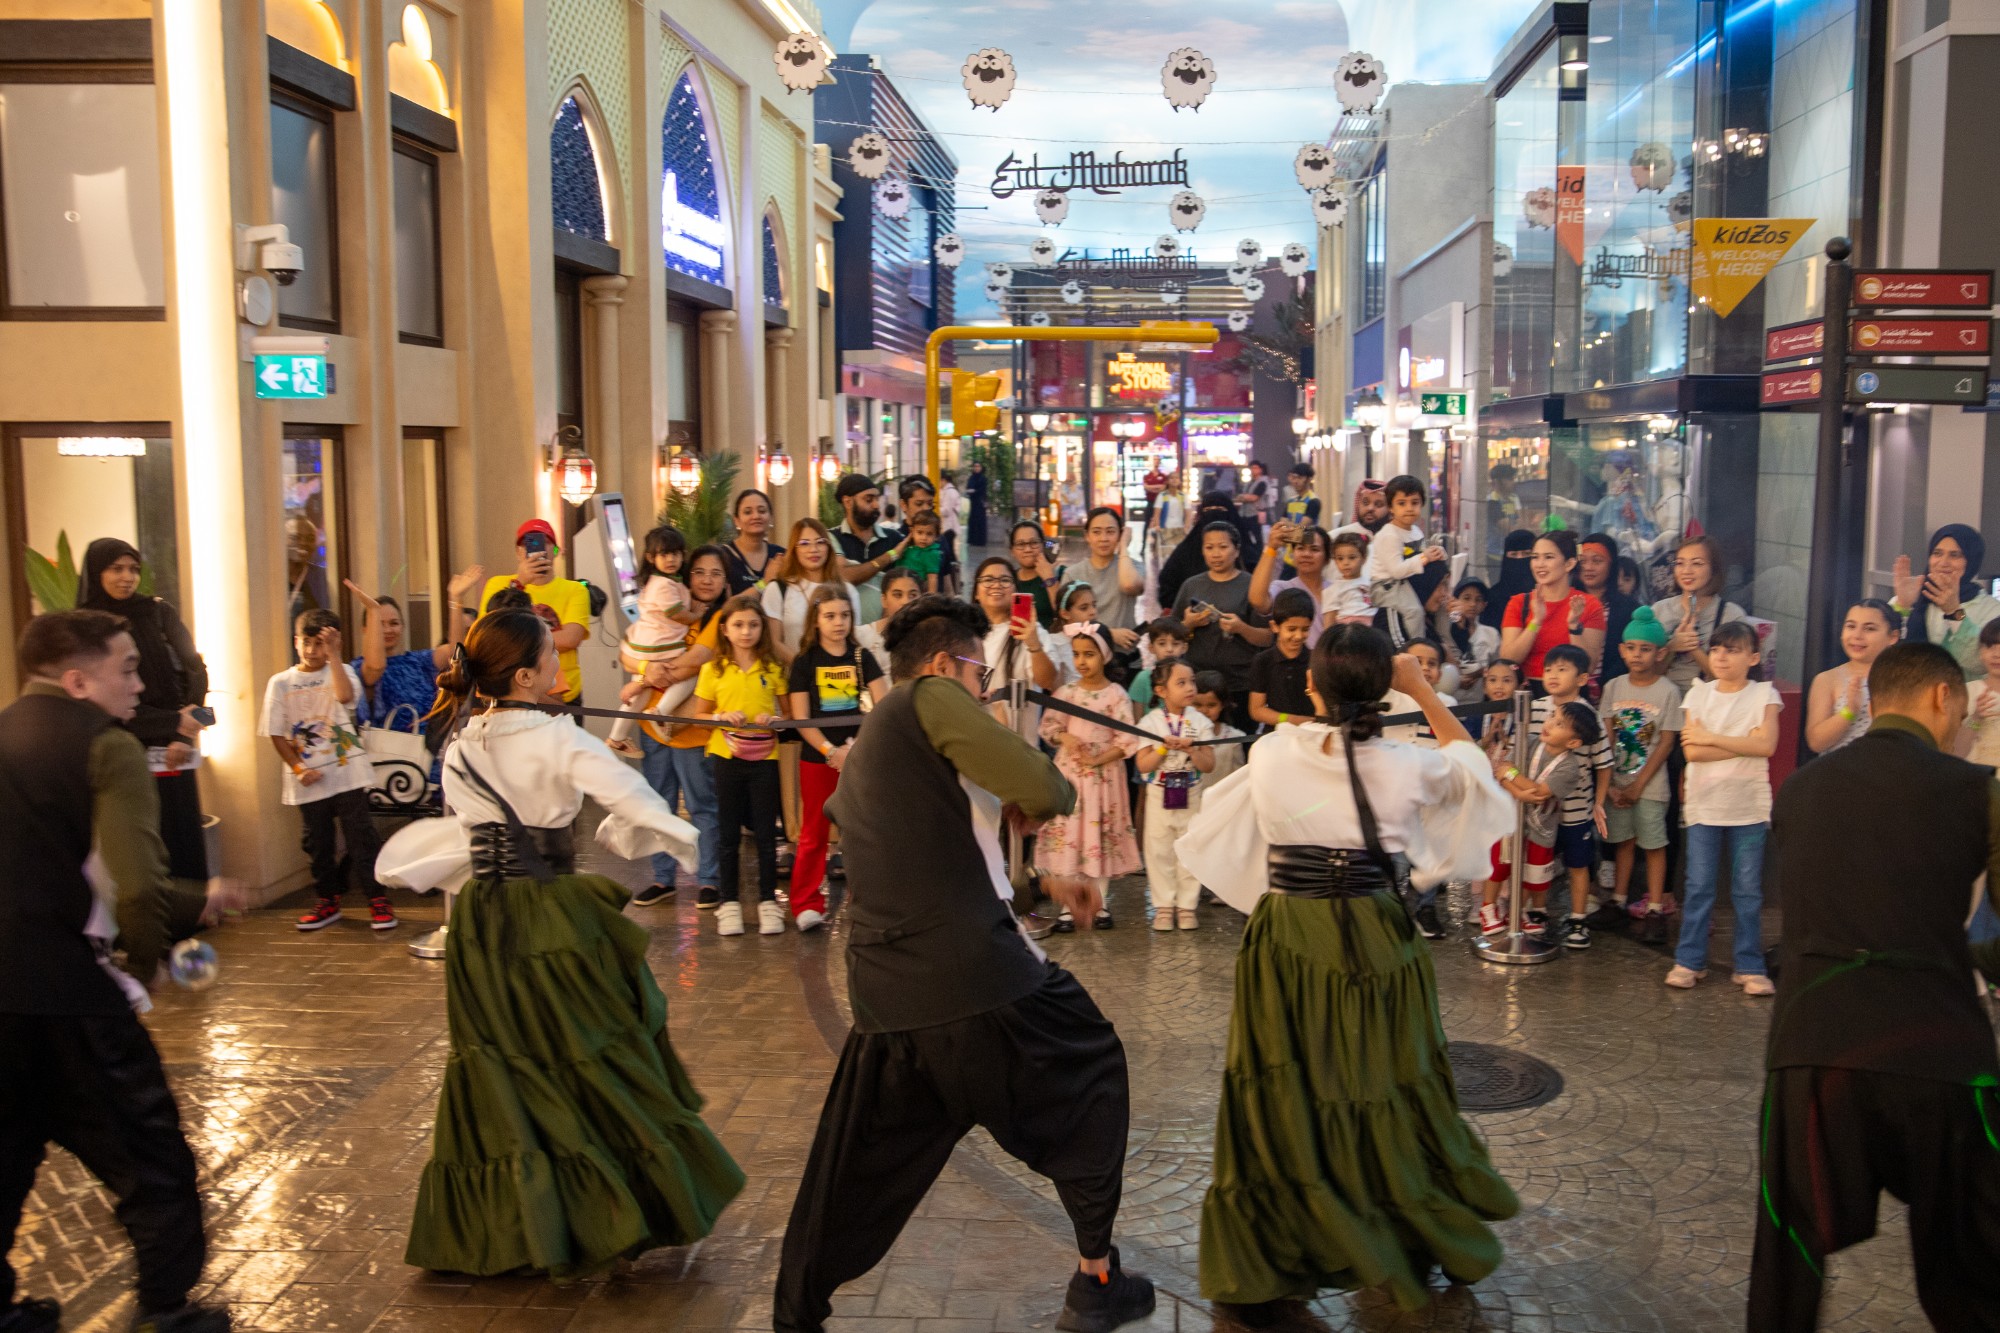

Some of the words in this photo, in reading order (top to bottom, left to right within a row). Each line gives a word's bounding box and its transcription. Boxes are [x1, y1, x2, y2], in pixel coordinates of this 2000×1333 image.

[990, 149, 1046, 200] Eid
[1050, 147, 1193, 195] Mubarak
[1557, 175, 1585, 194] id
[1711, 249, 1783, 261] WELCOME
[1715, 262, 1767, 276] HERE
[1108, 361, 1167, 376] NATIONAL
[1122, 371, 1172, 391] STORE
[825, 671, 851, 680] PUMA
